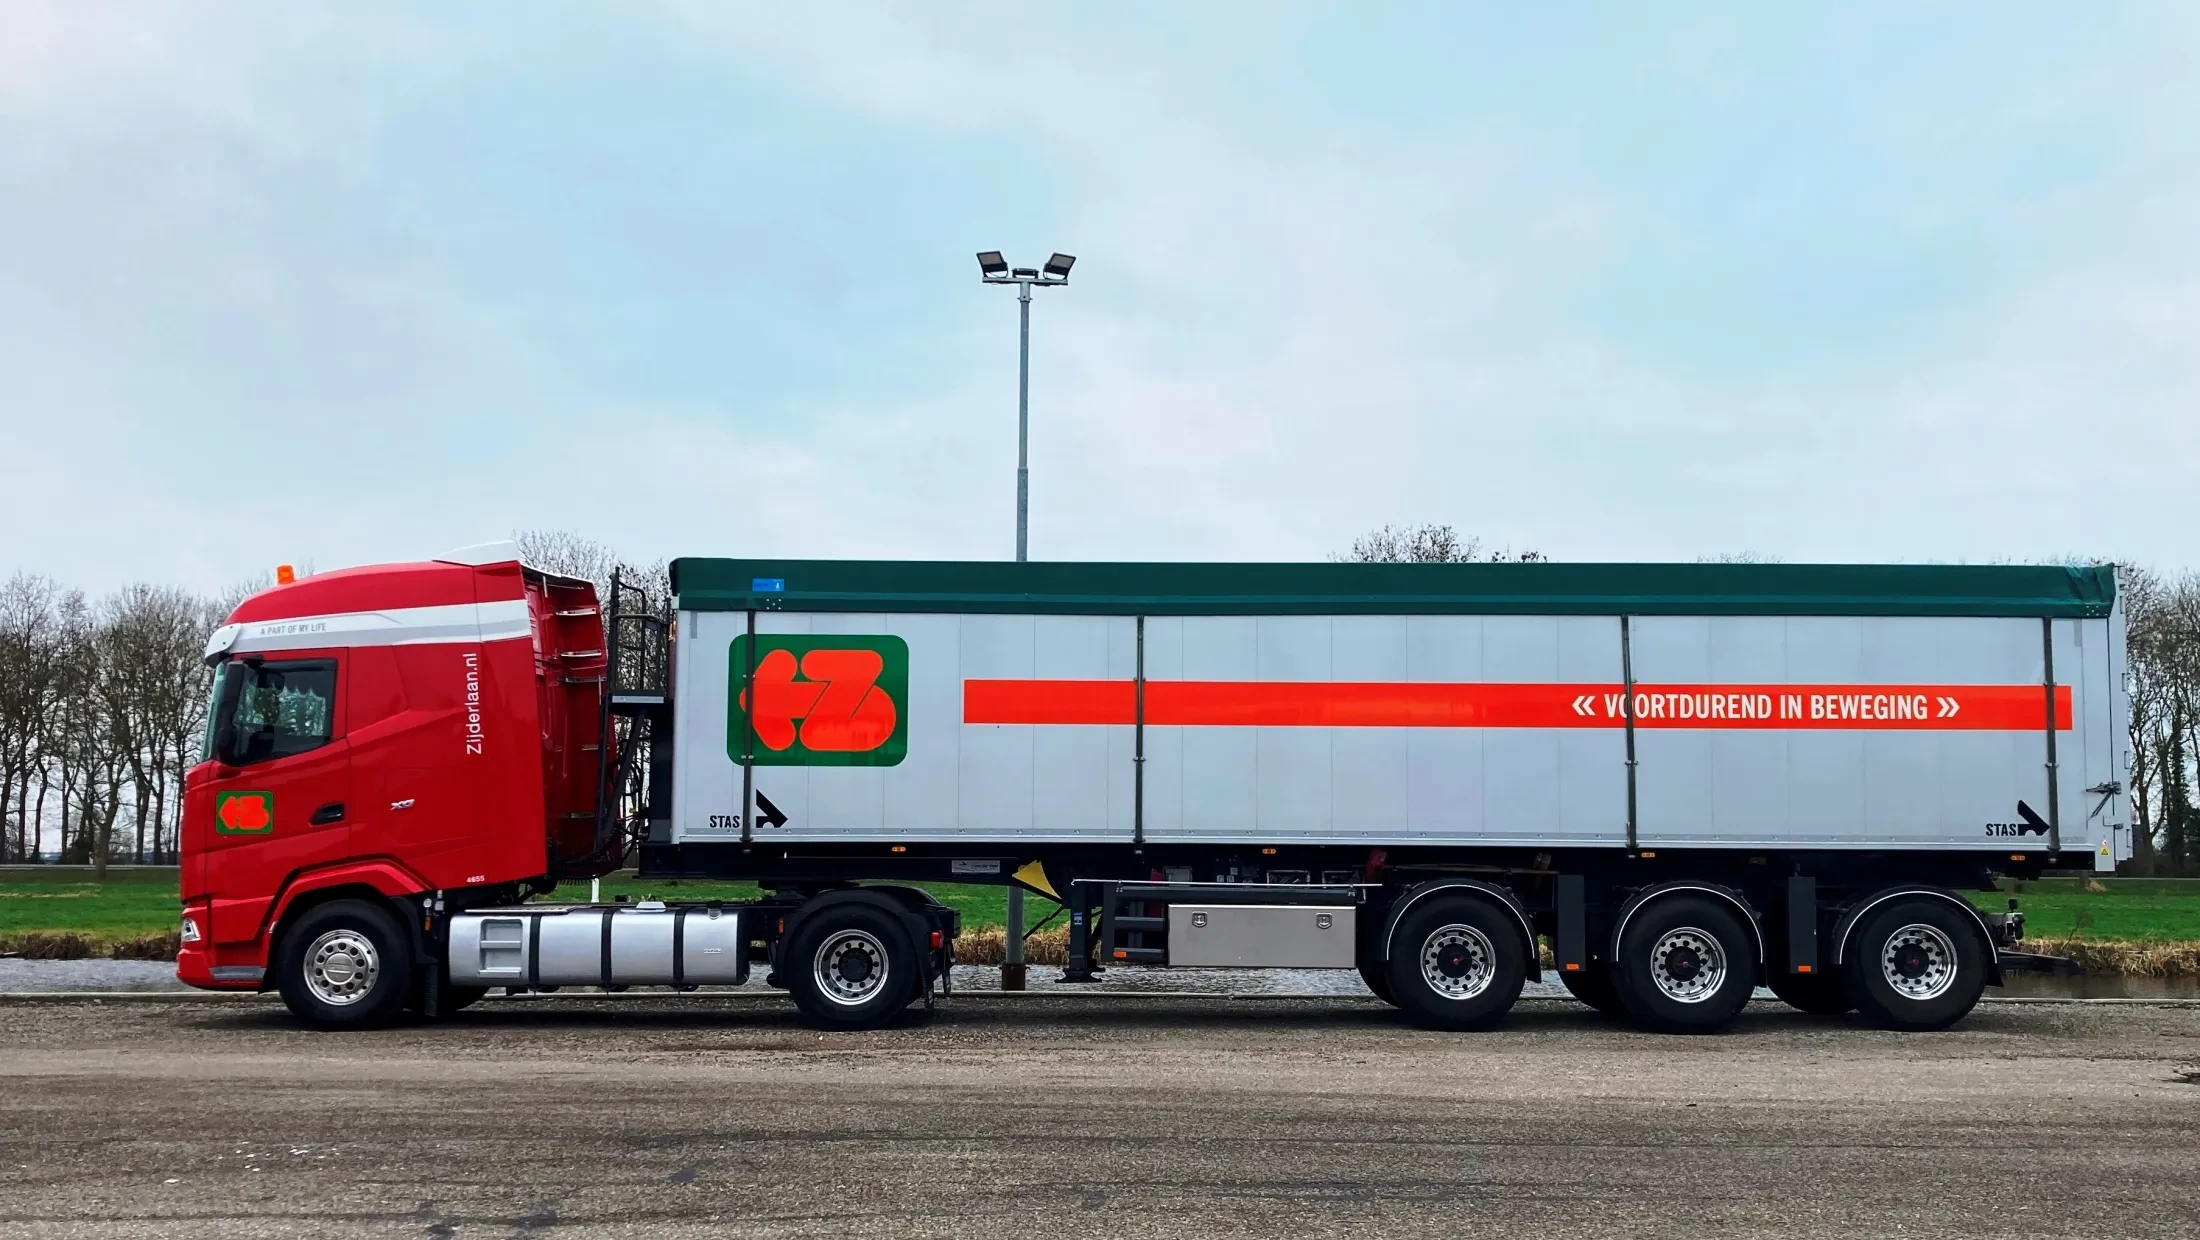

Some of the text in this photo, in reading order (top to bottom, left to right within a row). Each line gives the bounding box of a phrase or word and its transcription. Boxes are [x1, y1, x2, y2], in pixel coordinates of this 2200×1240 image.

[267, 625, 285, 635] PART
[288, 624, 297, 633] OF
[299, 624, 309, 632] MY
[311, 623, 326, 631] LIFE
[462, 653, 484, 754] Zijderlaan.nl
[1780, 694, 1802, 720] IN
[1810, 694, 1928, 720] BEWEGING
[709, 815, 740, 828] STAS
[1985, 823, 2017, 836] STAS
